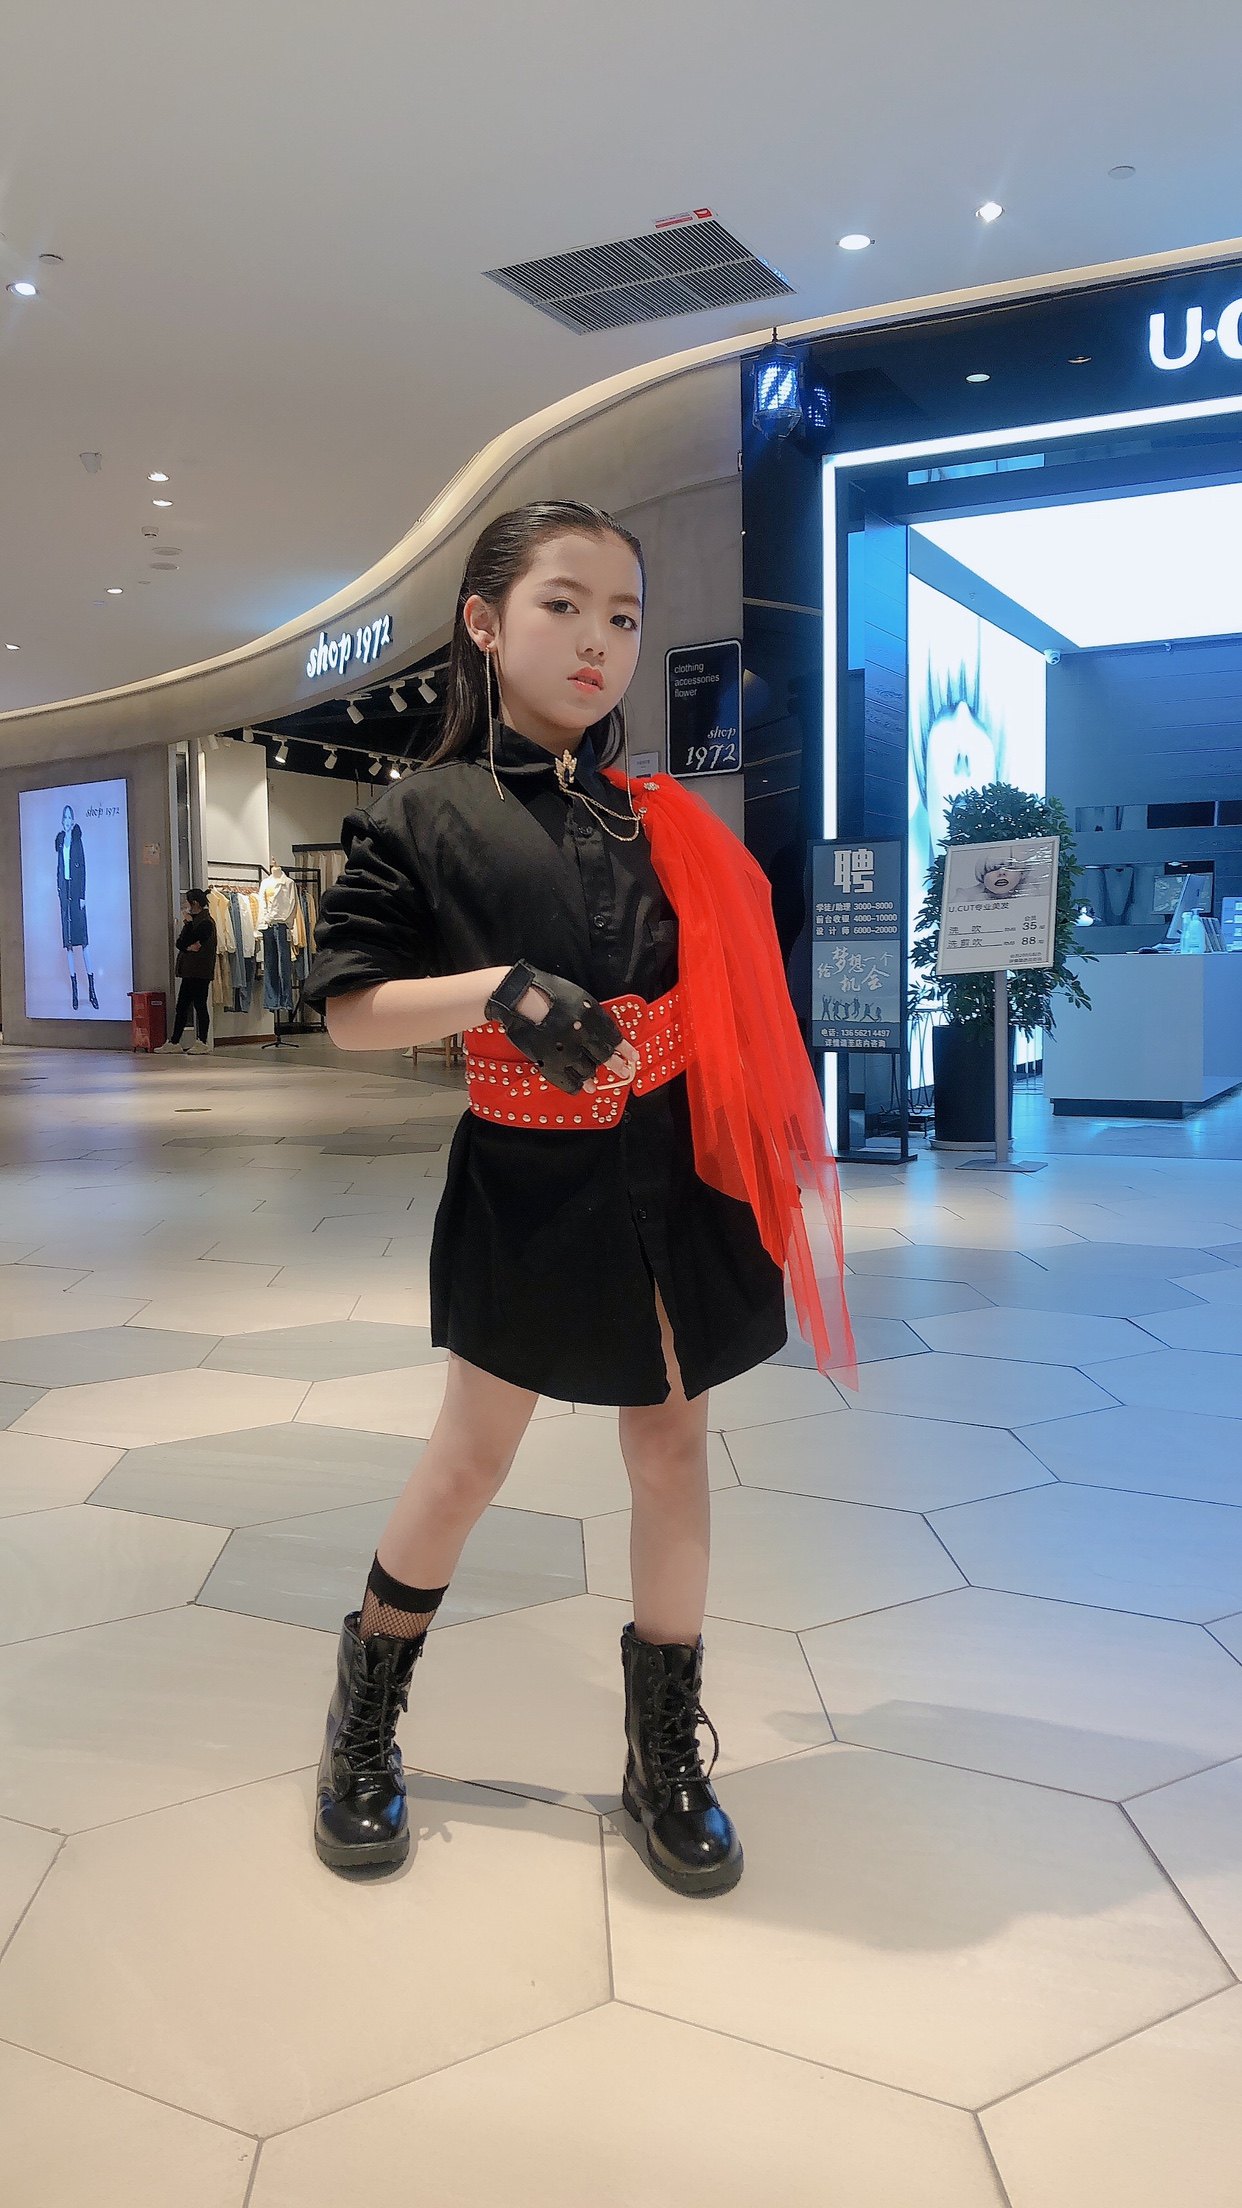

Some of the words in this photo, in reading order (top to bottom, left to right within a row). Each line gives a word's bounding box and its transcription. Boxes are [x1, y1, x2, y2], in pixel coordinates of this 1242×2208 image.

[306, 631, 352, 678] shop
[356, 614, 391, 664] 1972
[674, 663, 705, 674] clothing
[674, 673, 720, 687] accessories
[674, 688, 698, 698] flower
[707, 725, 736, 740] shop
[685, 742, 736, 771] 1972
[85, 804, 104, 818] shop
[833, 848, 875, 893] 聘
[1022, 921, 1037, 931] 35
[1021, 936, 1036, 945] 88
